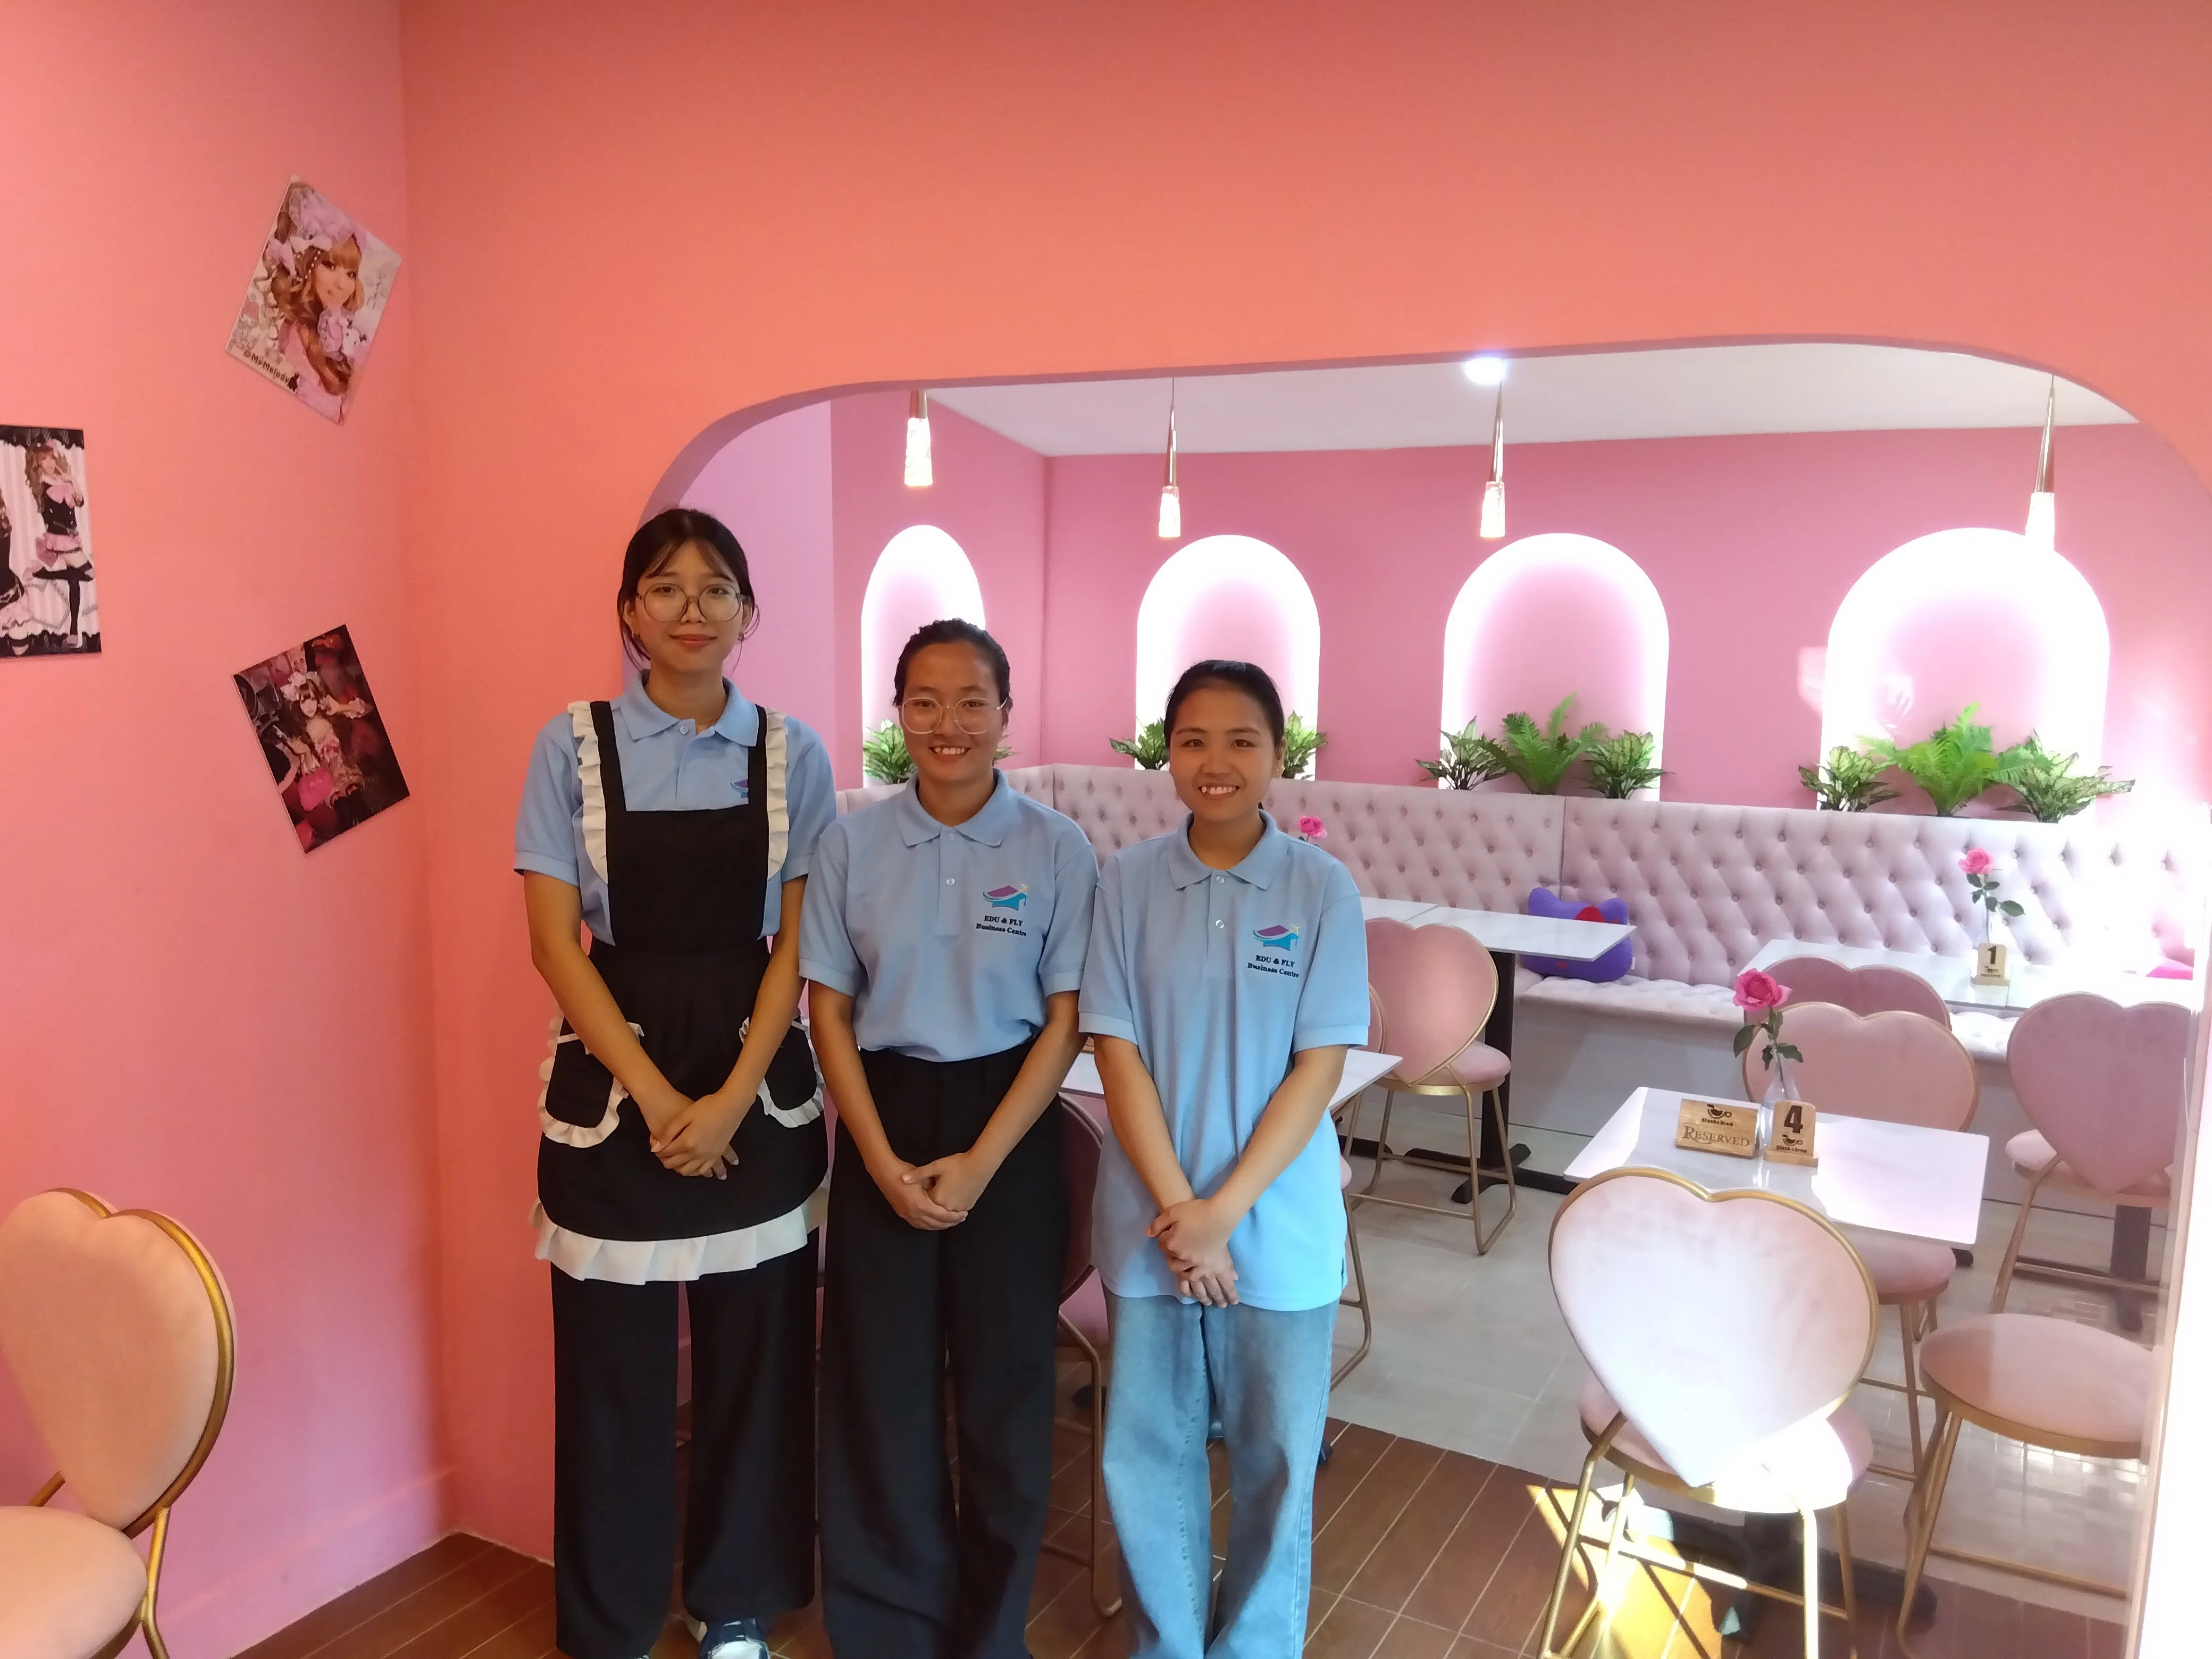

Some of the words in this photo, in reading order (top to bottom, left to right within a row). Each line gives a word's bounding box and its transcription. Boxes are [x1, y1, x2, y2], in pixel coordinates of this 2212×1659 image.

[976, 923, 1006, 932] Business
[1987, 945, 1997, 965] 1
[1247, 962, 1277, 973] Business
[1279, 968, 1299, 978] Centre
[1281, 959, 1295, 968] FLY
[1783, 1105, 1803, 1134] 4
